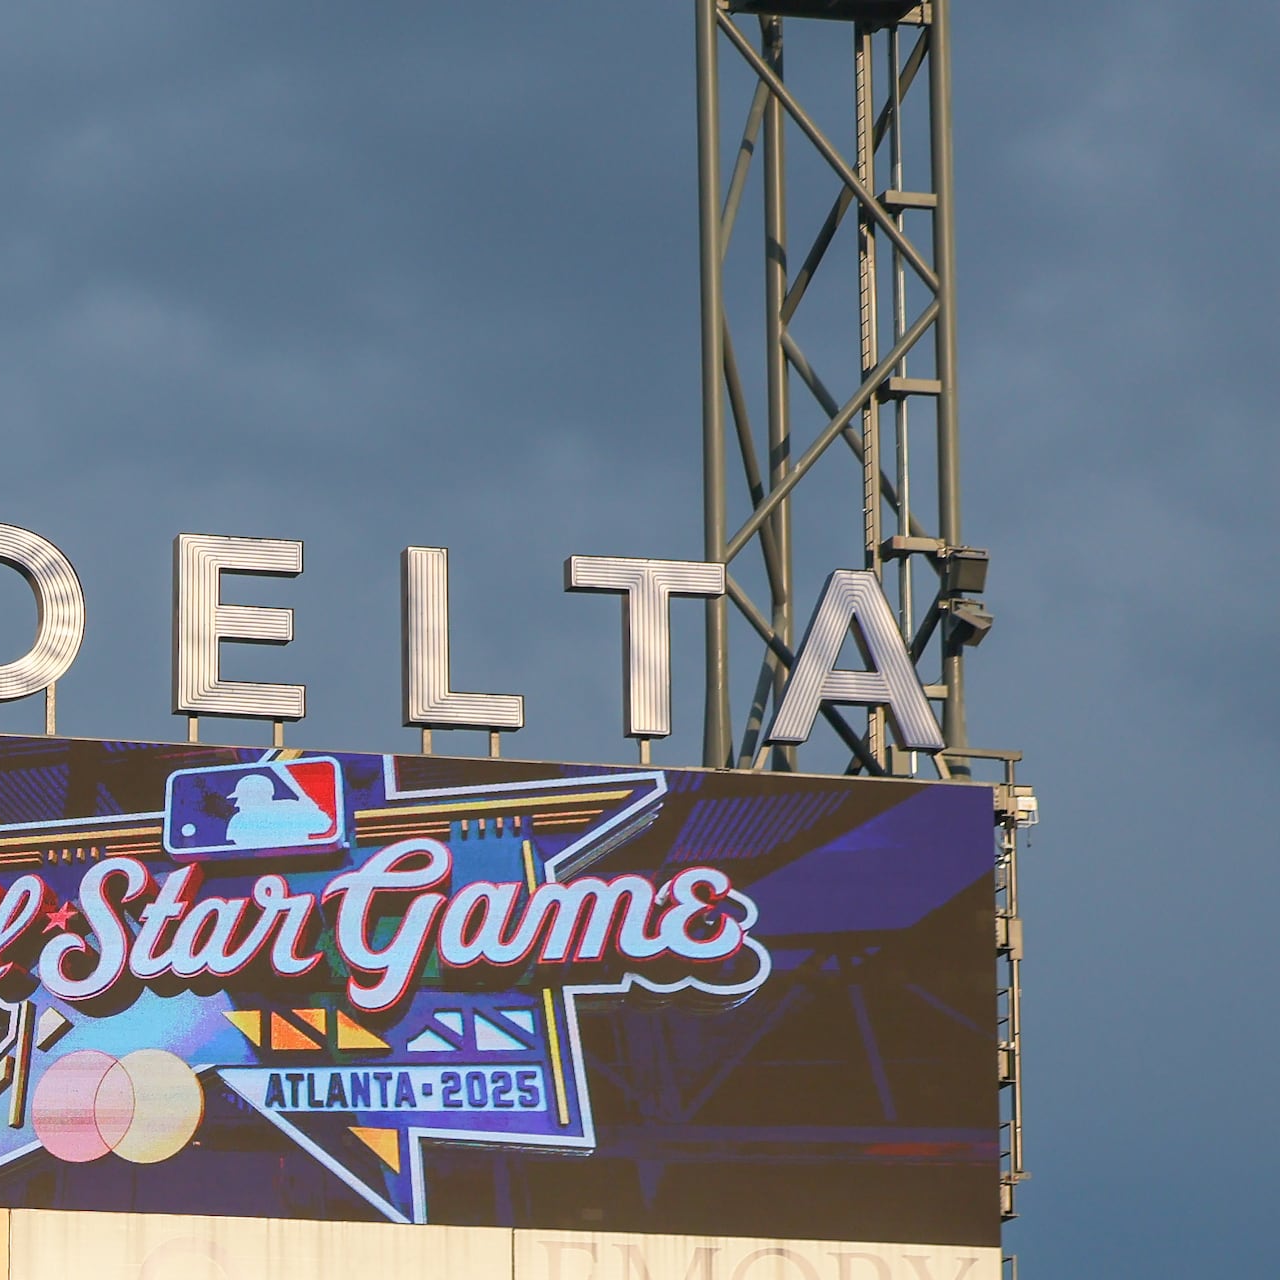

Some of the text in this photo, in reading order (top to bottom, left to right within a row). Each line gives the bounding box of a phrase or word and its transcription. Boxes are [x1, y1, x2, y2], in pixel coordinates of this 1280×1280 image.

[40, 856, 324, 1002] Star
[322, 837, 751, 1012] Game
[265, 1069, 541, 1109] ATLANTA 2025
